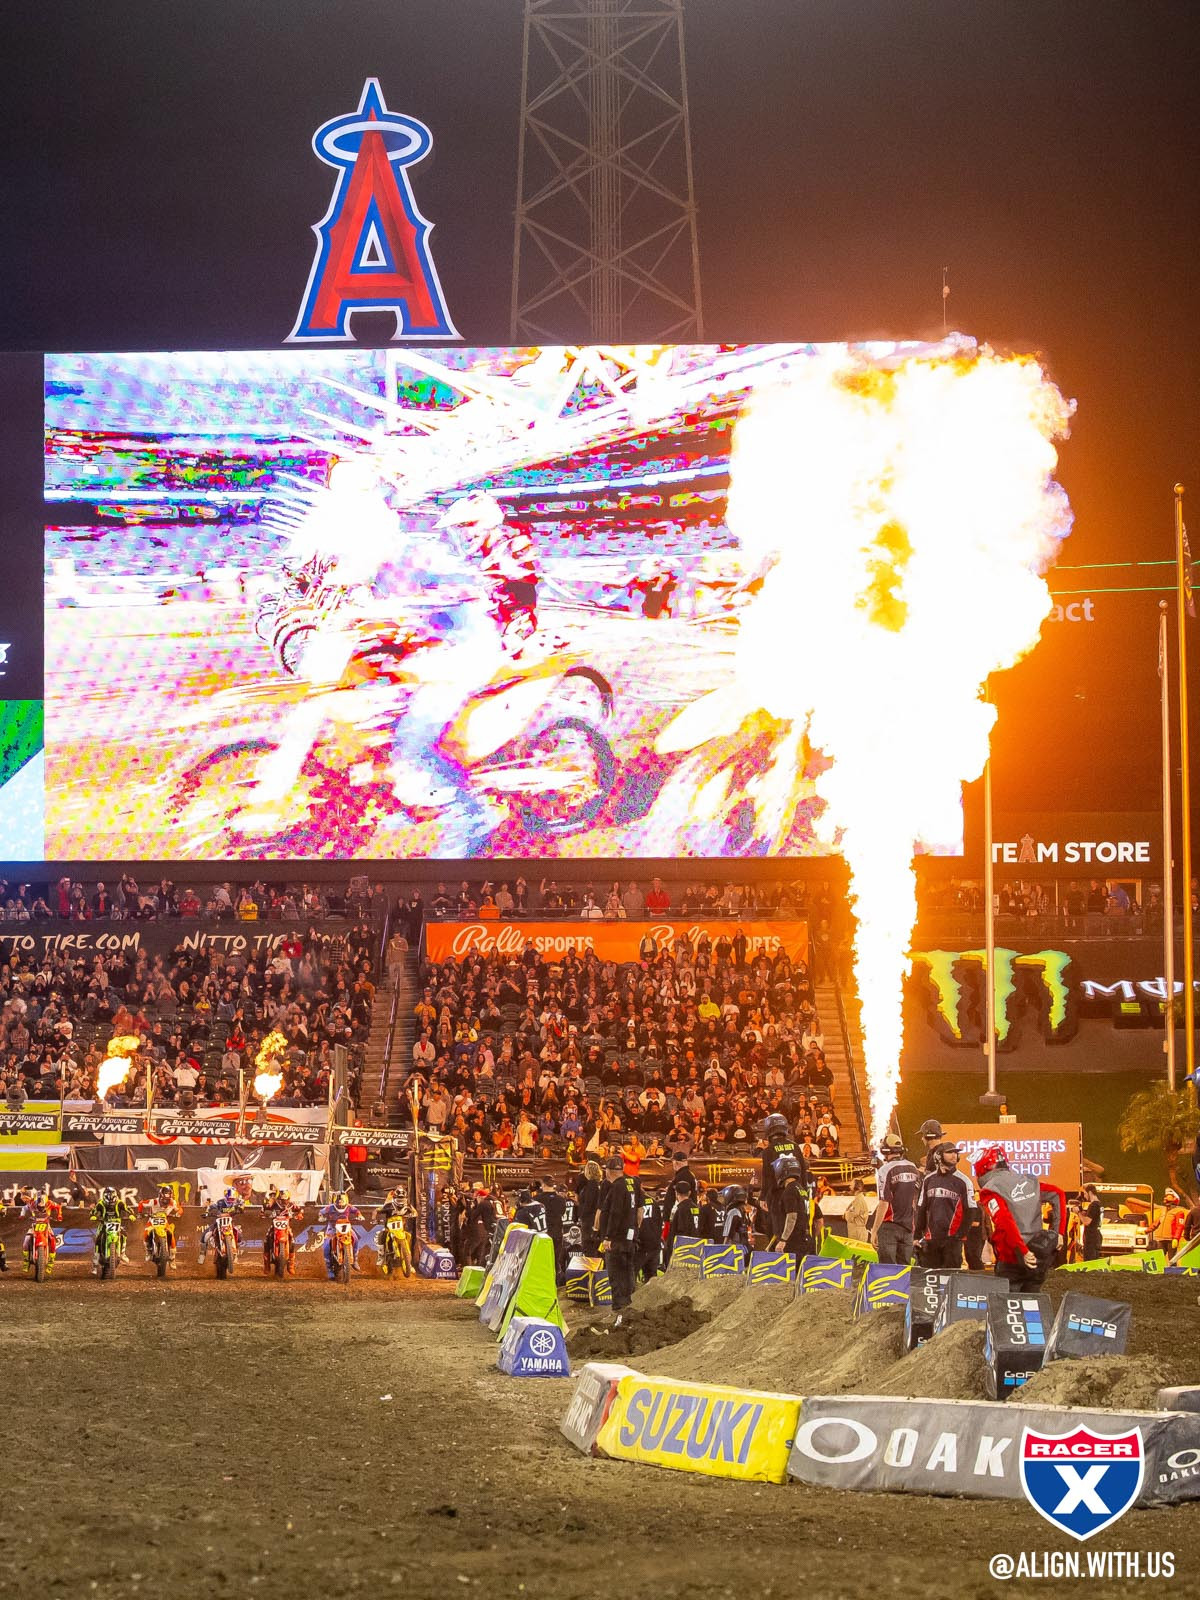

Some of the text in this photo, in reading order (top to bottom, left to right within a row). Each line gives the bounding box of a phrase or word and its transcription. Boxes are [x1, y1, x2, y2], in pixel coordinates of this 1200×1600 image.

[991, 834, 1150, 863] TEAM STORE
[42, 932, 140, 953] TIRE.COM
[182, 930, 247, 951] NITTO
[535, 936, 594, 953] SPORTS
[1080, 976, 1200, 1001] MO
[16, 1114, 54, 1123] MOUNTAIN
[195, 1120, 231, 1128] MOUNTAIN
[261, 1123, 320, 1133] ROCKY MOUNTAIN
[350, 1130, 409, 1139] ROCKY MOUNTAIN
[34, 1223, 47, 1232] 18
[107, 1222, 120, 1232] 21
[152, 1218, 166, 1226] 52
[275, 1221, 288, 1229] 96
[391, 1221, 401, 1230] 11
[533, 1214, 547, 1231] 17
[341, 1224, 347, 1233] 1
[924, 1274, 939, 1314] GoPro
[957, 1294, 987, 1302] GoP
[1006, 1299, 1027, 1345] GoPro
[1068, 1314, 1118, 1331] GoPro
[521, 1357, 562, 1370] YAMAHA
[1004, 1370, 1036, 1379] GoP
[618, 1388, 765, 1464] SUZUKI
[883, 1428, 1013, 1478] OAK
